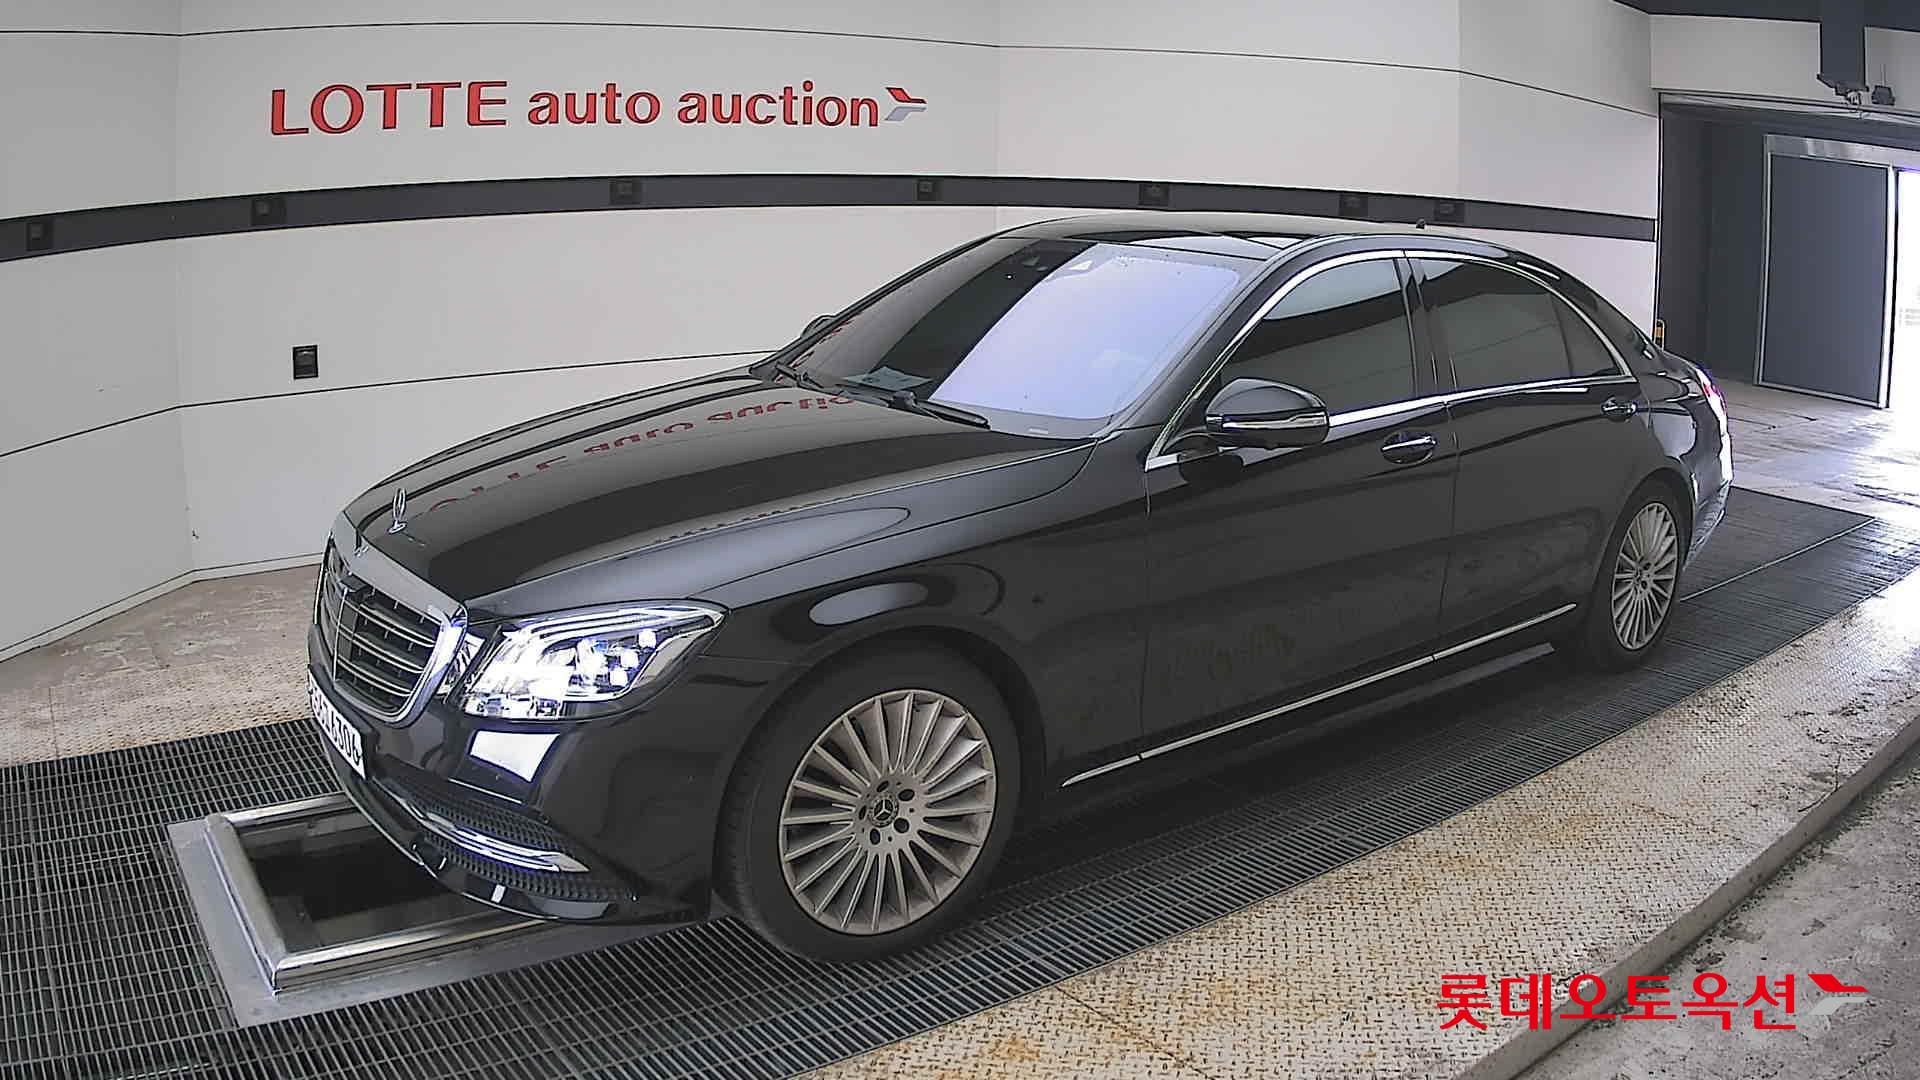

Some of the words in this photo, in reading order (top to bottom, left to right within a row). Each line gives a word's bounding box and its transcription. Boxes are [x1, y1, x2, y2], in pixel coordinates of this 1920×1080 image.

[270, 80, 507, 136] LOTTE
[527, 82, 662, 126] auto
[677, 80, 880, 128] auction
